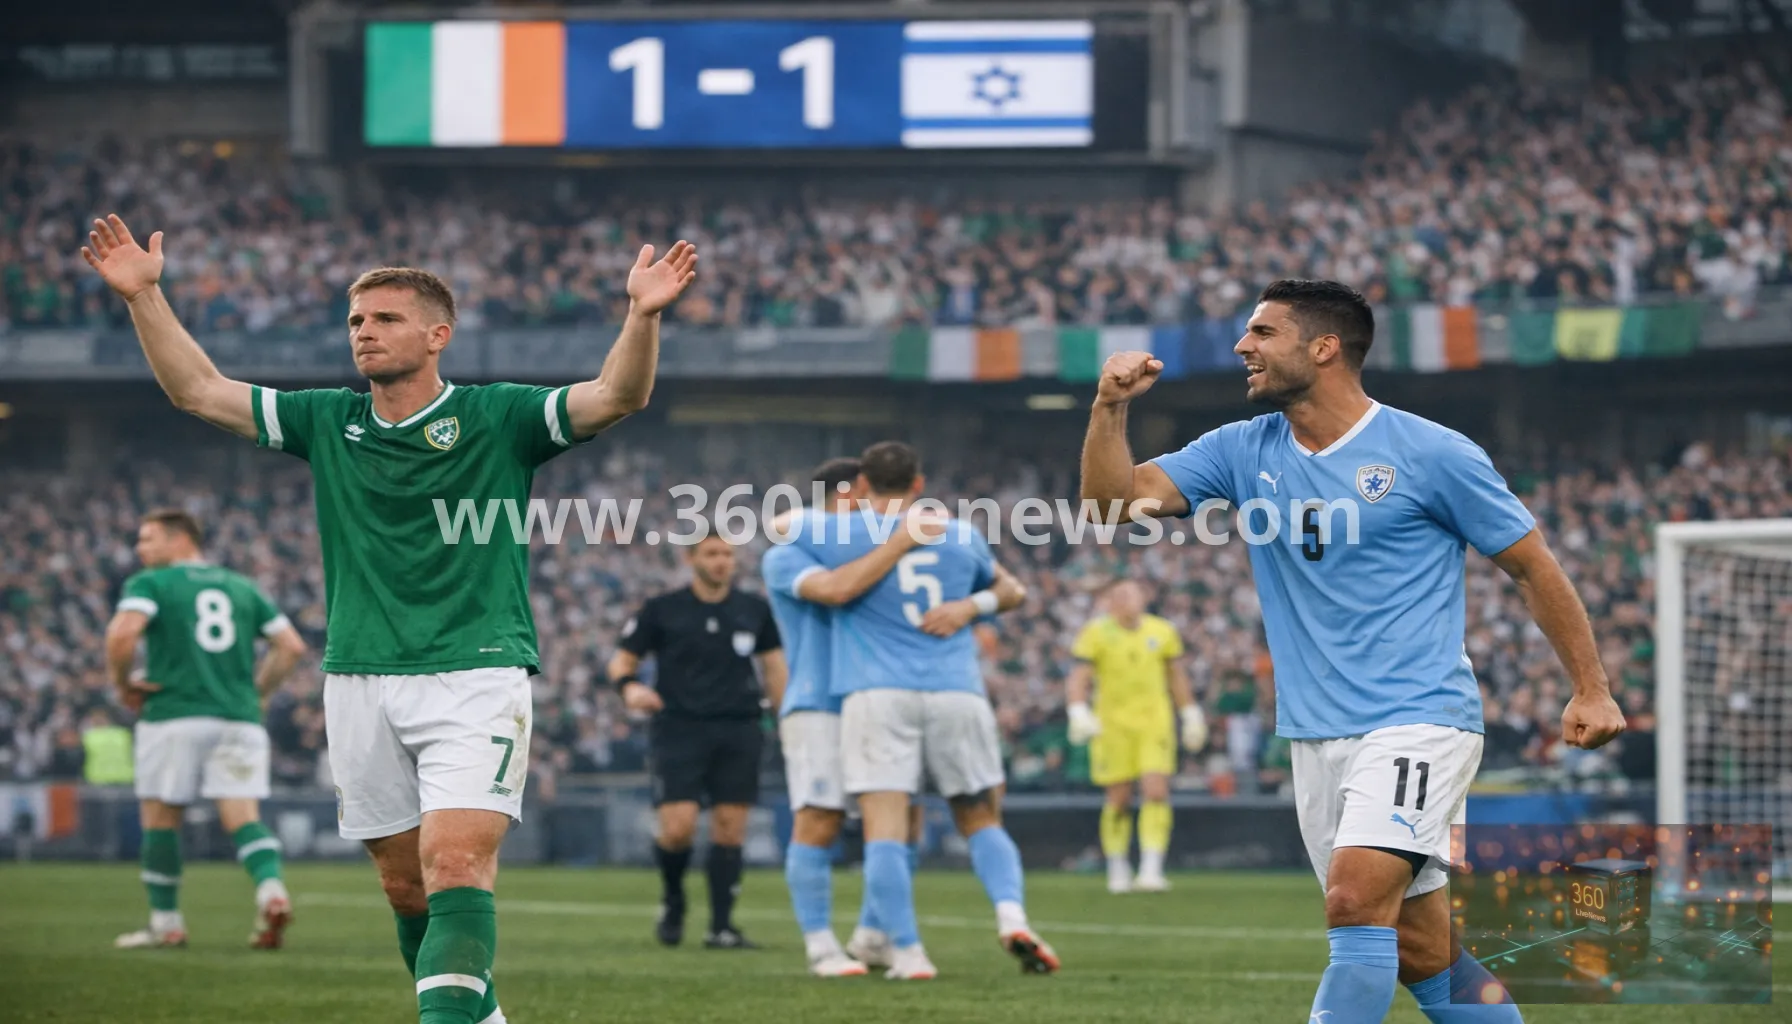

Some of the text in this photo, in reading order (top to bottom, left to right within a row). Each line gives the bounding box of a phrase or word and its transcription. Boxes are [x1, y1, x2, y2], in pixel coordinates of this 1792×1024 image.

[608, 35, 835, 130] 1 - 1
[194, 588, 237, 653] 8
[897, 551, 943, 630] 5
[491, 735, 514, 783] 7
[1393, 757, 1430, 811] 11
